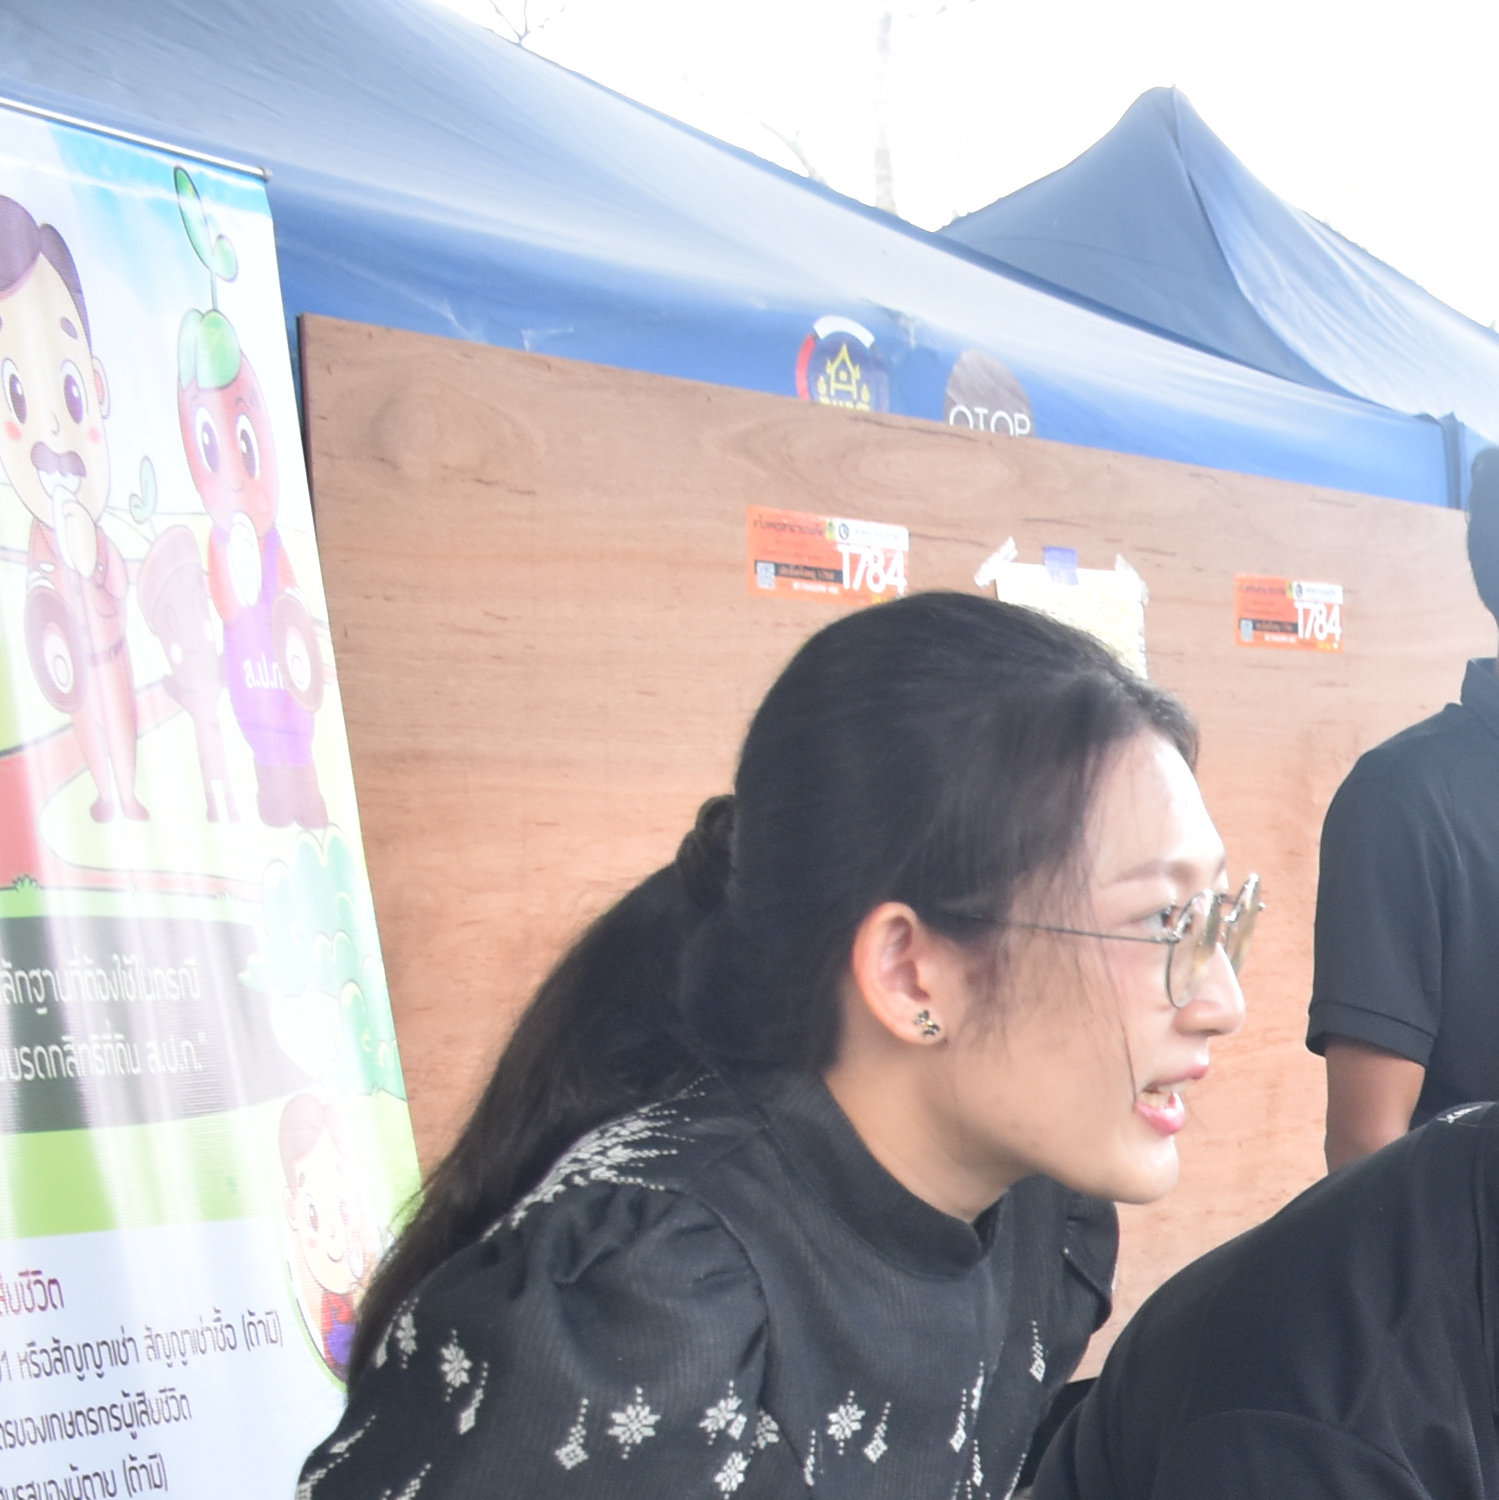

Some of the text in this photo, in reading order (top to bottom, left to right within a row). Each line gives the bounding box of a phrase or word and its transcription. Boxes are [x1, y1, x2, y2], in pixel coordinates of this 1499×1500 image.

[837, 543, 907, 595] 1784
[1294, 600, 1341, 641] 1784
[241, 1309, 284, 1352] (ถ้ามี)
[122, 1453, 169, 1500] (ถ้ามี)
